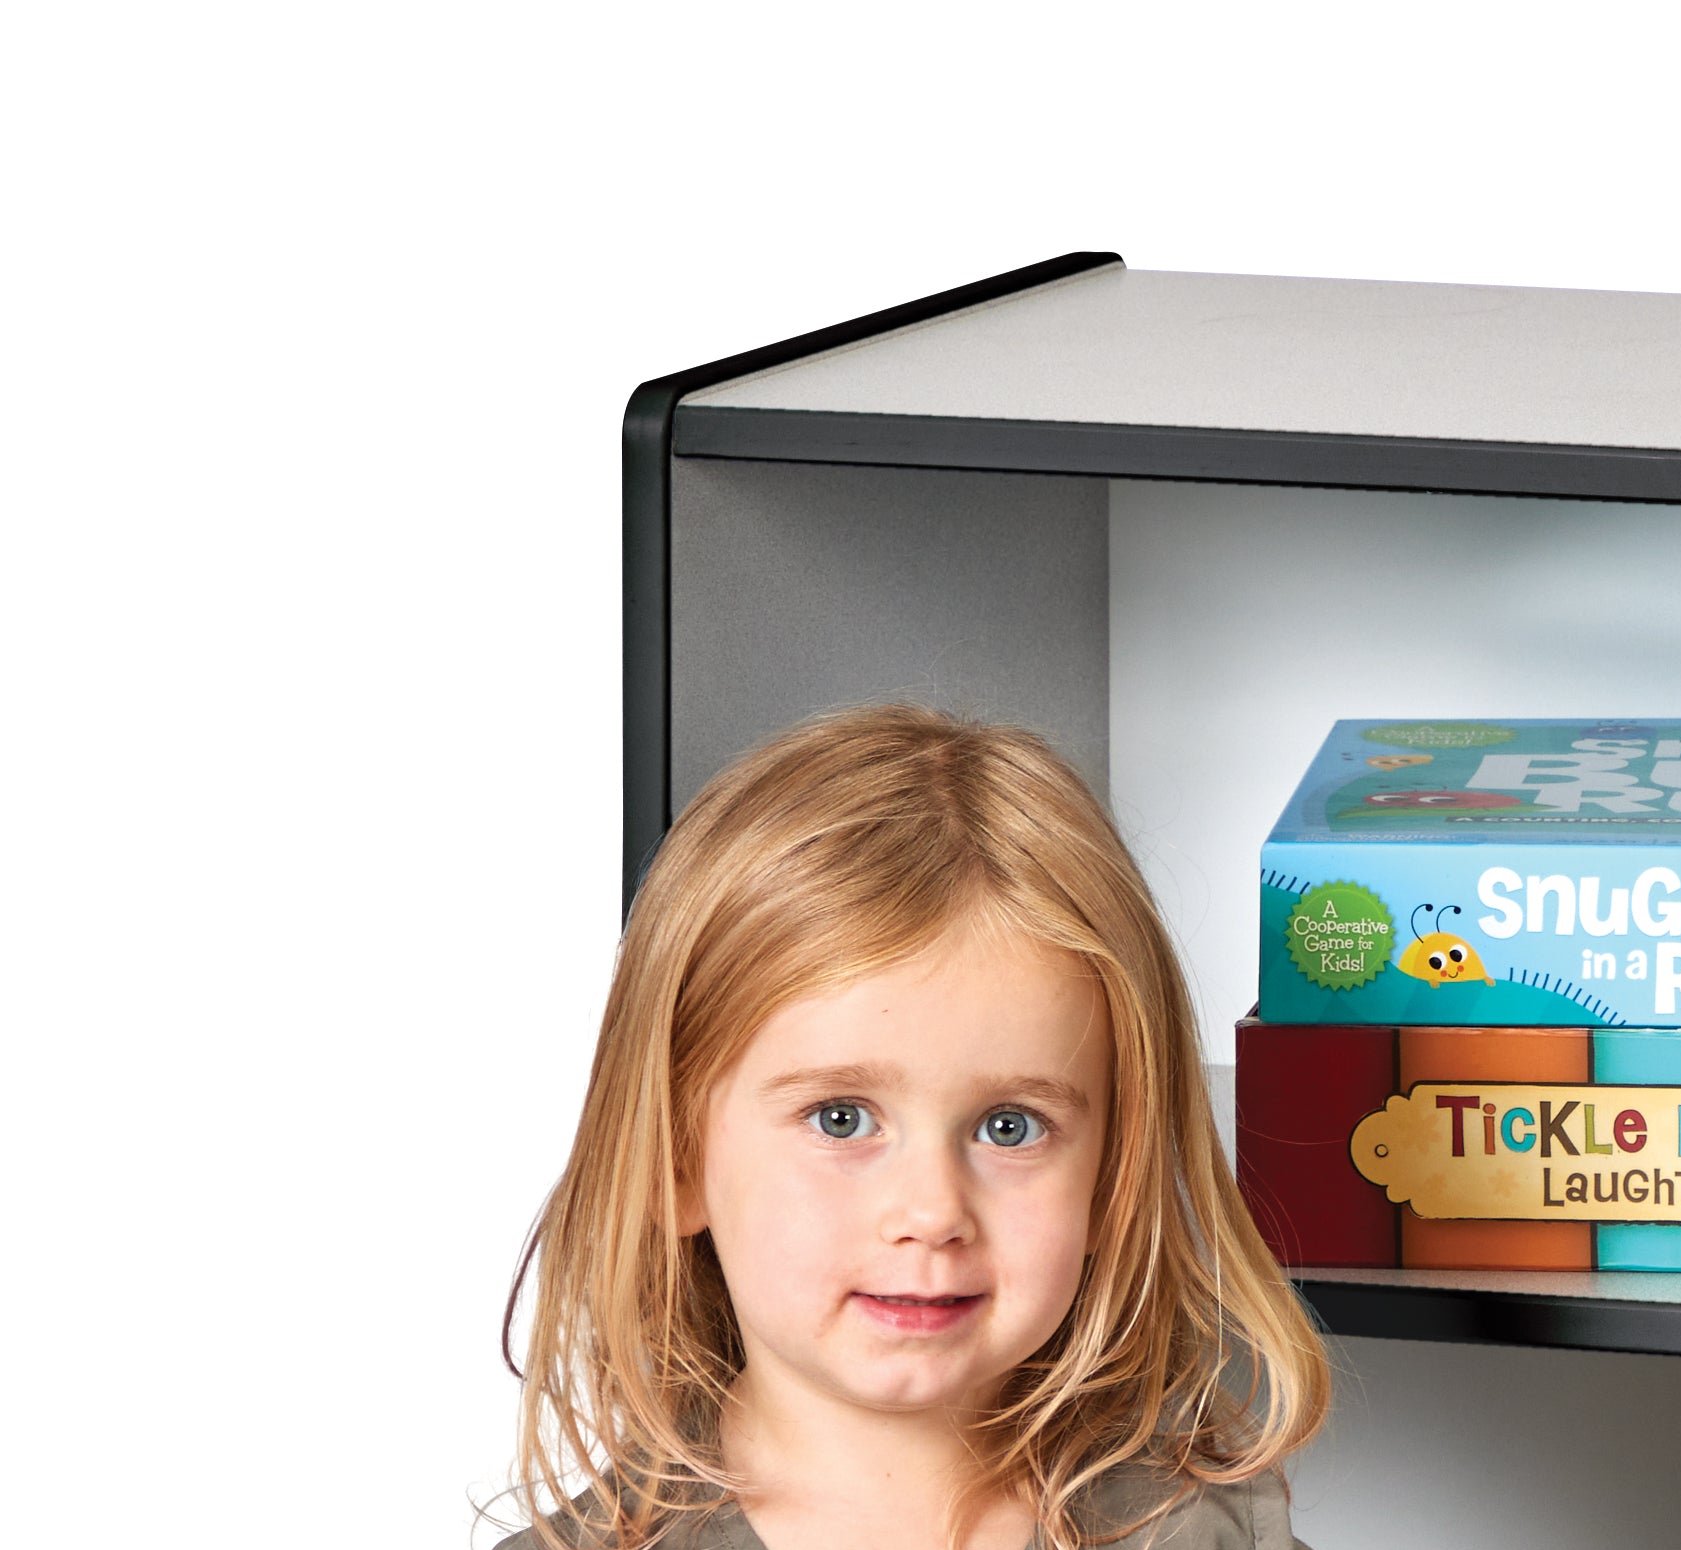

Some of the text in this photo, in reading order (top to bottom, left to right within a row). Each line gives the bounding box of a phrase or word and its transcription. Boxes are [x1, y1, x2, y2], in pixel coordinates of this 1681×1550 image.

[1322, 900, 1338, 919] A
[1293, 916, 1389, 936] Cooperative
[1304, 934, 1374, 952] Game for
[1321, 952, 1364, 972] Kids!
[1581, 948, 1616, 980] in
[1625, 949, 1647, 980] a
